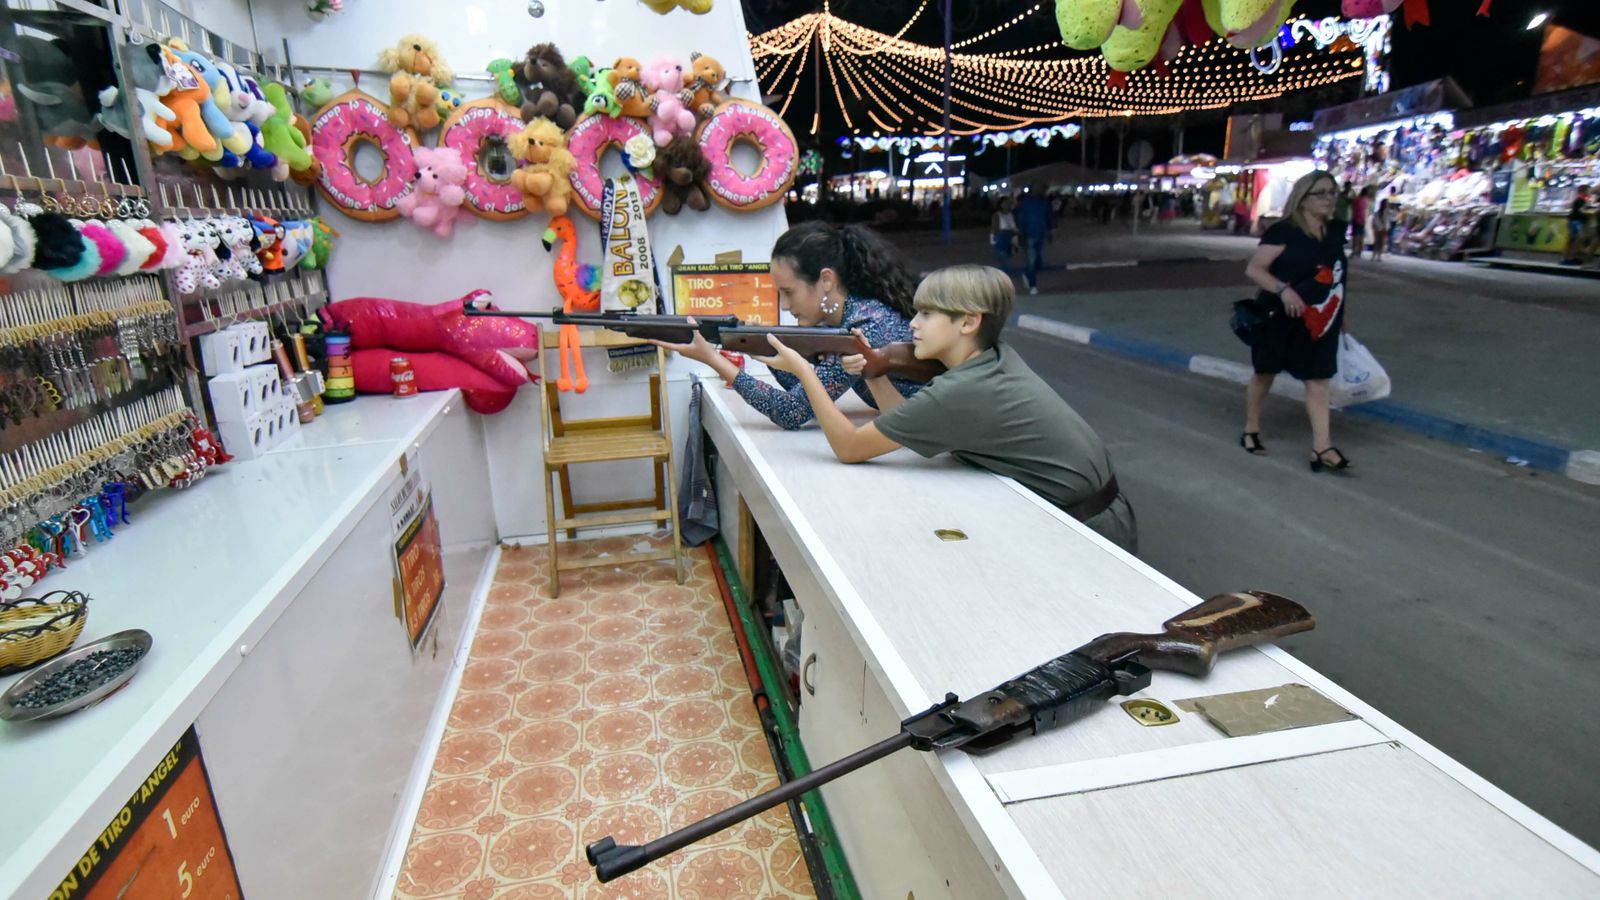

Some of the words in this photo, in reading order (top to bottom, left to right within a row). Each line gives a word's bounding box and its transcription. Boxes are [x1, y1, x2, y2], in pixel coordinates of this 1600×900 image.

[630, 191, 642, 221] 2013
[637, 237, 649, 270] 2008
[688, 277, 715, 290] TIRO
[754, 277, 760, 289] 1
[689, 297, 724, 309] TIROS
[752, 296, 760, 308] 5
[162, 808, 178, 840] 1
[180, 796, 200, 826] euro
[79, 846, 101, 878] DE
[99, 806, 132, 851] TIRO
[177, 860, 193, 899] 5
[196, 845, 216, 877] euro
